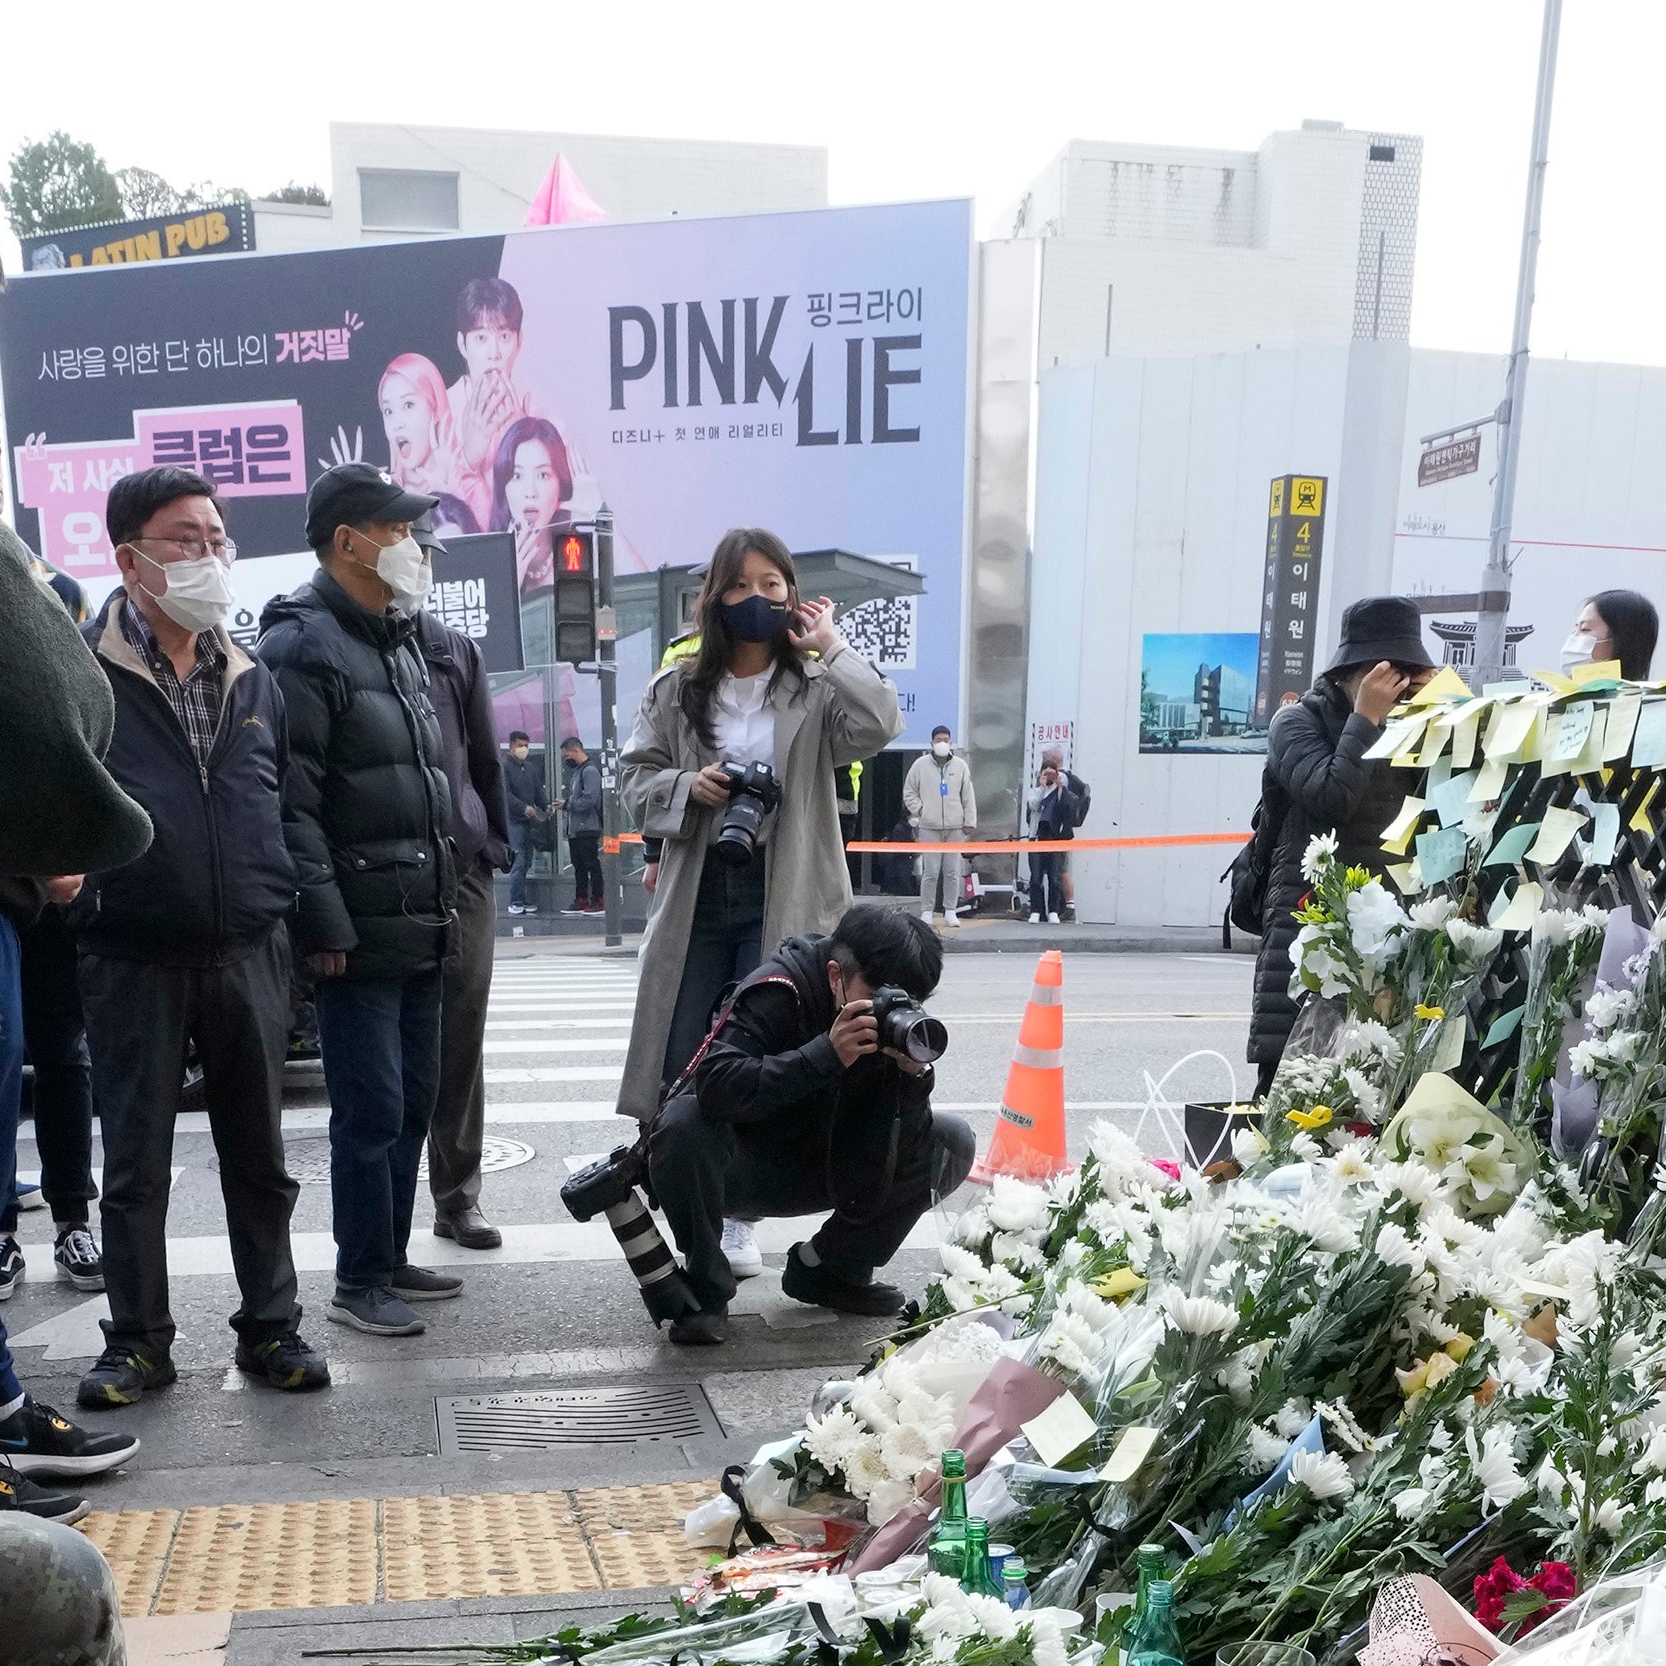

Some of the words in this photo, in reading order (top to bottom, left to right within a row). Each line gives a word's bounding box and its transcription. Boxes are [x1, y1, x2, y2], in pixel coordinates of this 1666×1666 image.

[165, 210, 230, 258] PUB
[807, 286, 923, 328] 핑크라이
[37, 346, 107, 382] 사랑을
[111, 341, 161, 376] 위한
[165, 339, 190, 373] 단
[195, 332, 269, 371] 하나의
[274, 326, 352, 365] 거짓말
[607, 295, 791, 410] PINK
[790, 332, 923, 447] LIE
[152, 423, 292, 485] 클럽은
[611, 427, 666, 444] 디즈니+
[675, 426, 687, 442] 첫
[694, 424, 721, 441] 연애
[728, 421, 784, 440] 리얼리티
[48, 461, 76, 494] 저
[1296, 520, 1312, 545] 4
[423, 577, 486, 611] 더불어
[1288, 561, 1309, 641] 이태원
[1037, 723, 1071, 741] 공사안내
